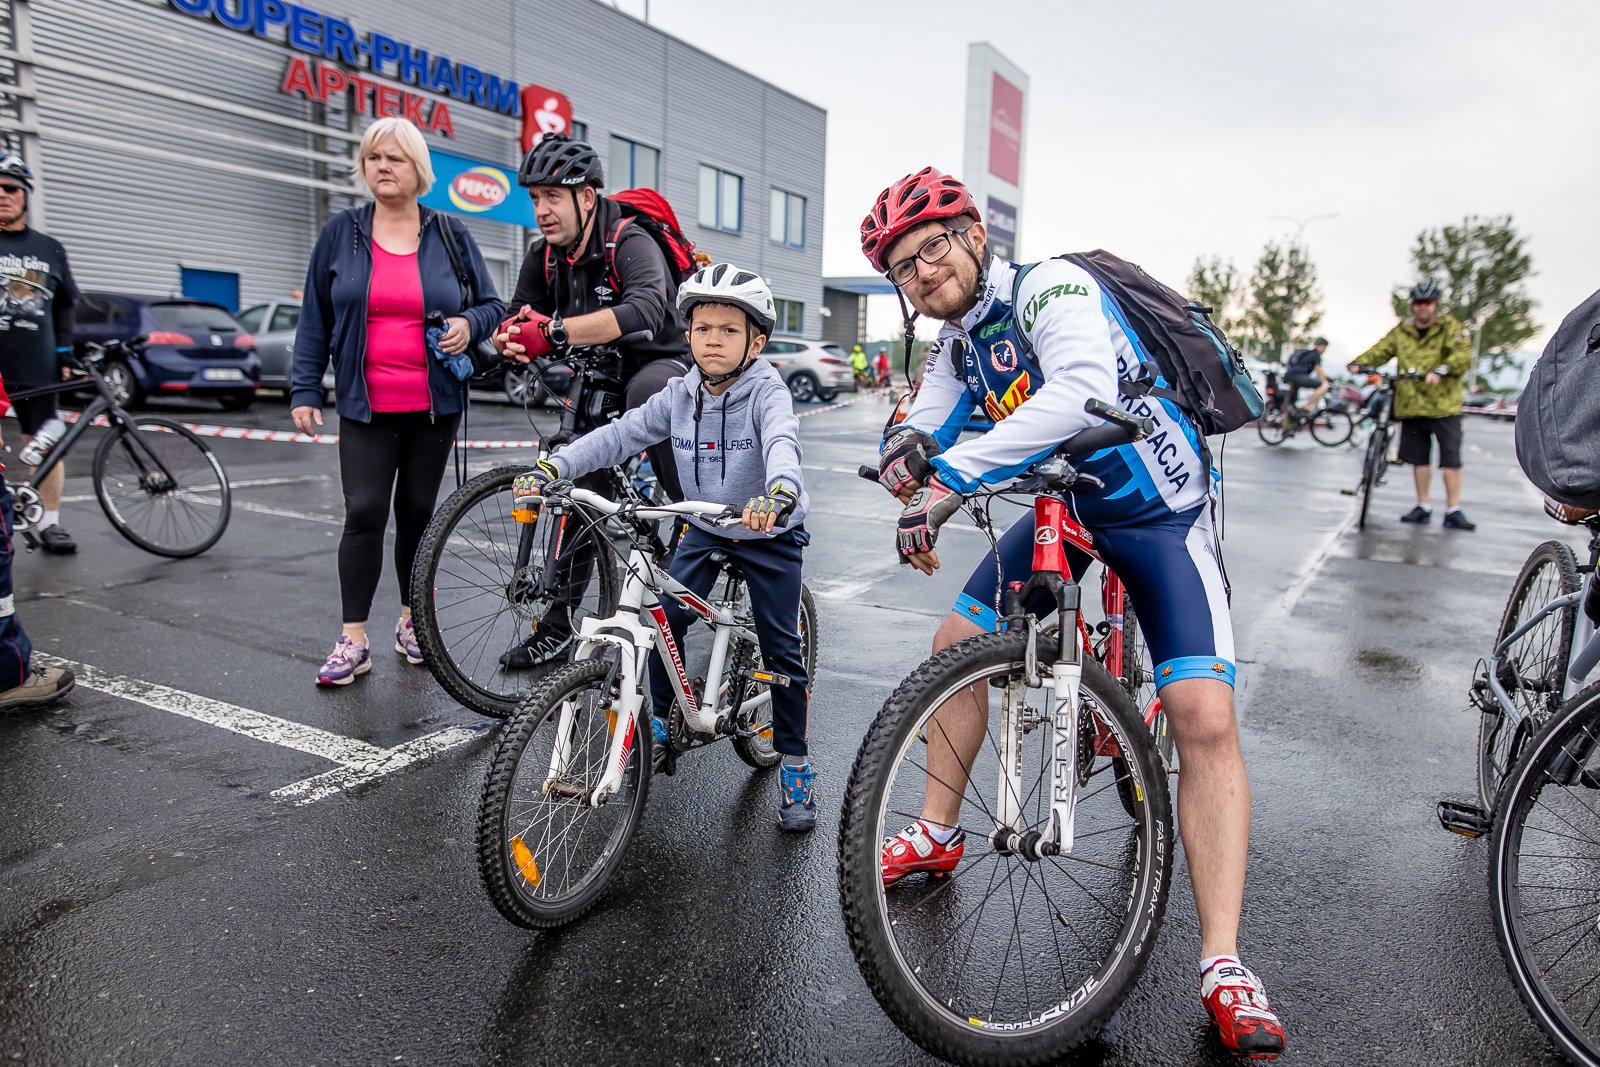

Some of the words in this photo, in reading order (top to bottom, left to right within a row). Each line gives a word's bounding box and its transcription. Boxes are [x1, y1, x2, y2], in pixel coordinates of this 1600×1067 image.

[282, 56, 456, 138] APTEKA
[457, 175, 504, 206] PEPCO
[561, 175, 586, 185] LAZER
[672, 435, 696, 453] TOMM
[717, 438, 754, 451] HLFIGER
[660, 620, 689, 686] SPECIALIZED
[1155, 819, 1165, 866] FAST
[1147, 867, 1163, 917] TRAK
